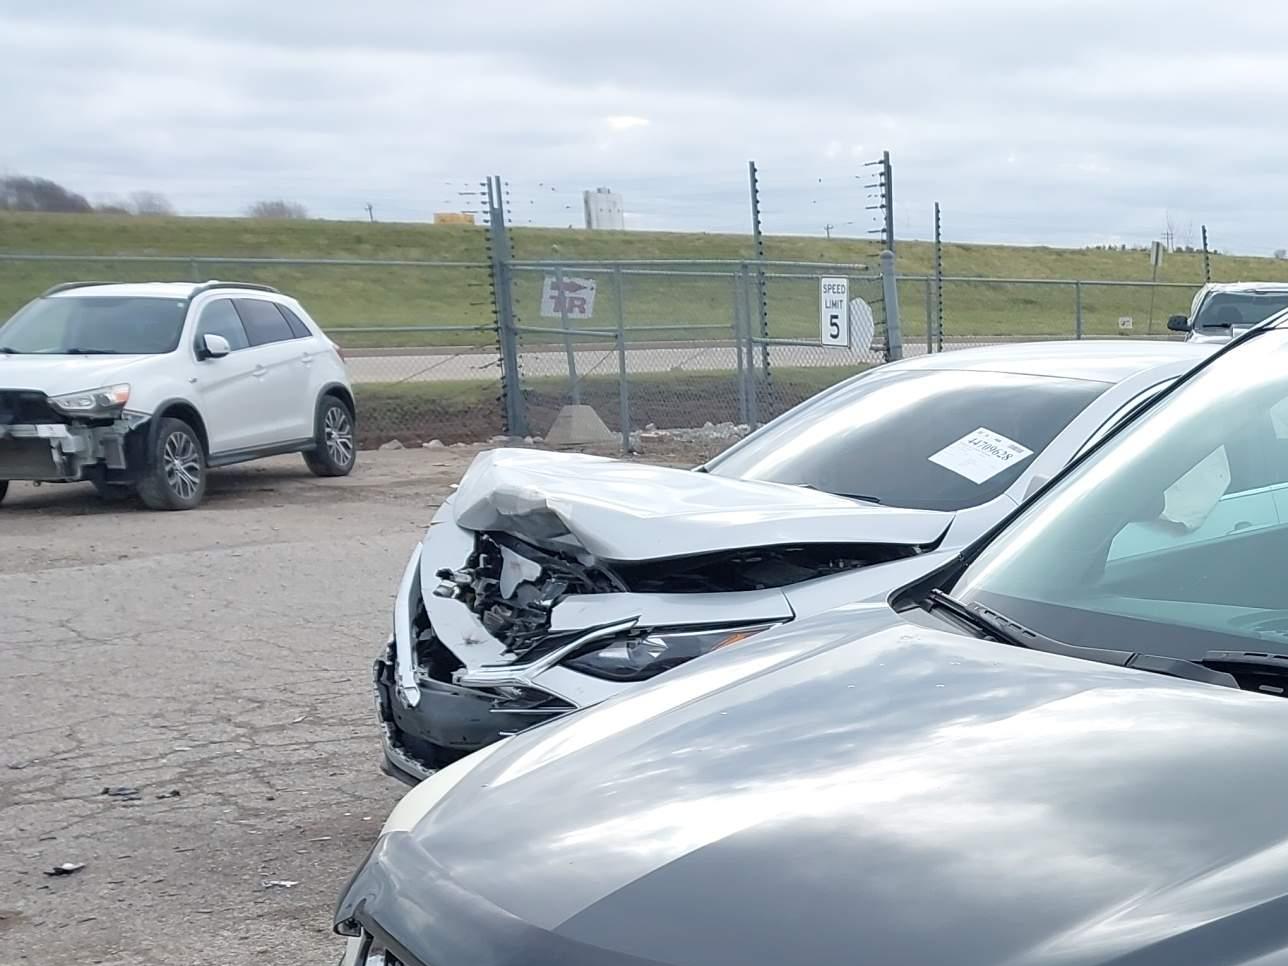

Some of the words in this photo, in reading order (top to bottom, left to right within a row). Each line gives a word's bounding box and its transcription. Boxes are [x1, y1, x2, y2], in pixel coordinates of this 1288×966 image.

[823, 283, 846, 294] SPEED
[825, 299, 843, 310] LIMIT
[830, 314, 840, 339] 5
[968, 437, 1014, 461] 44709628
